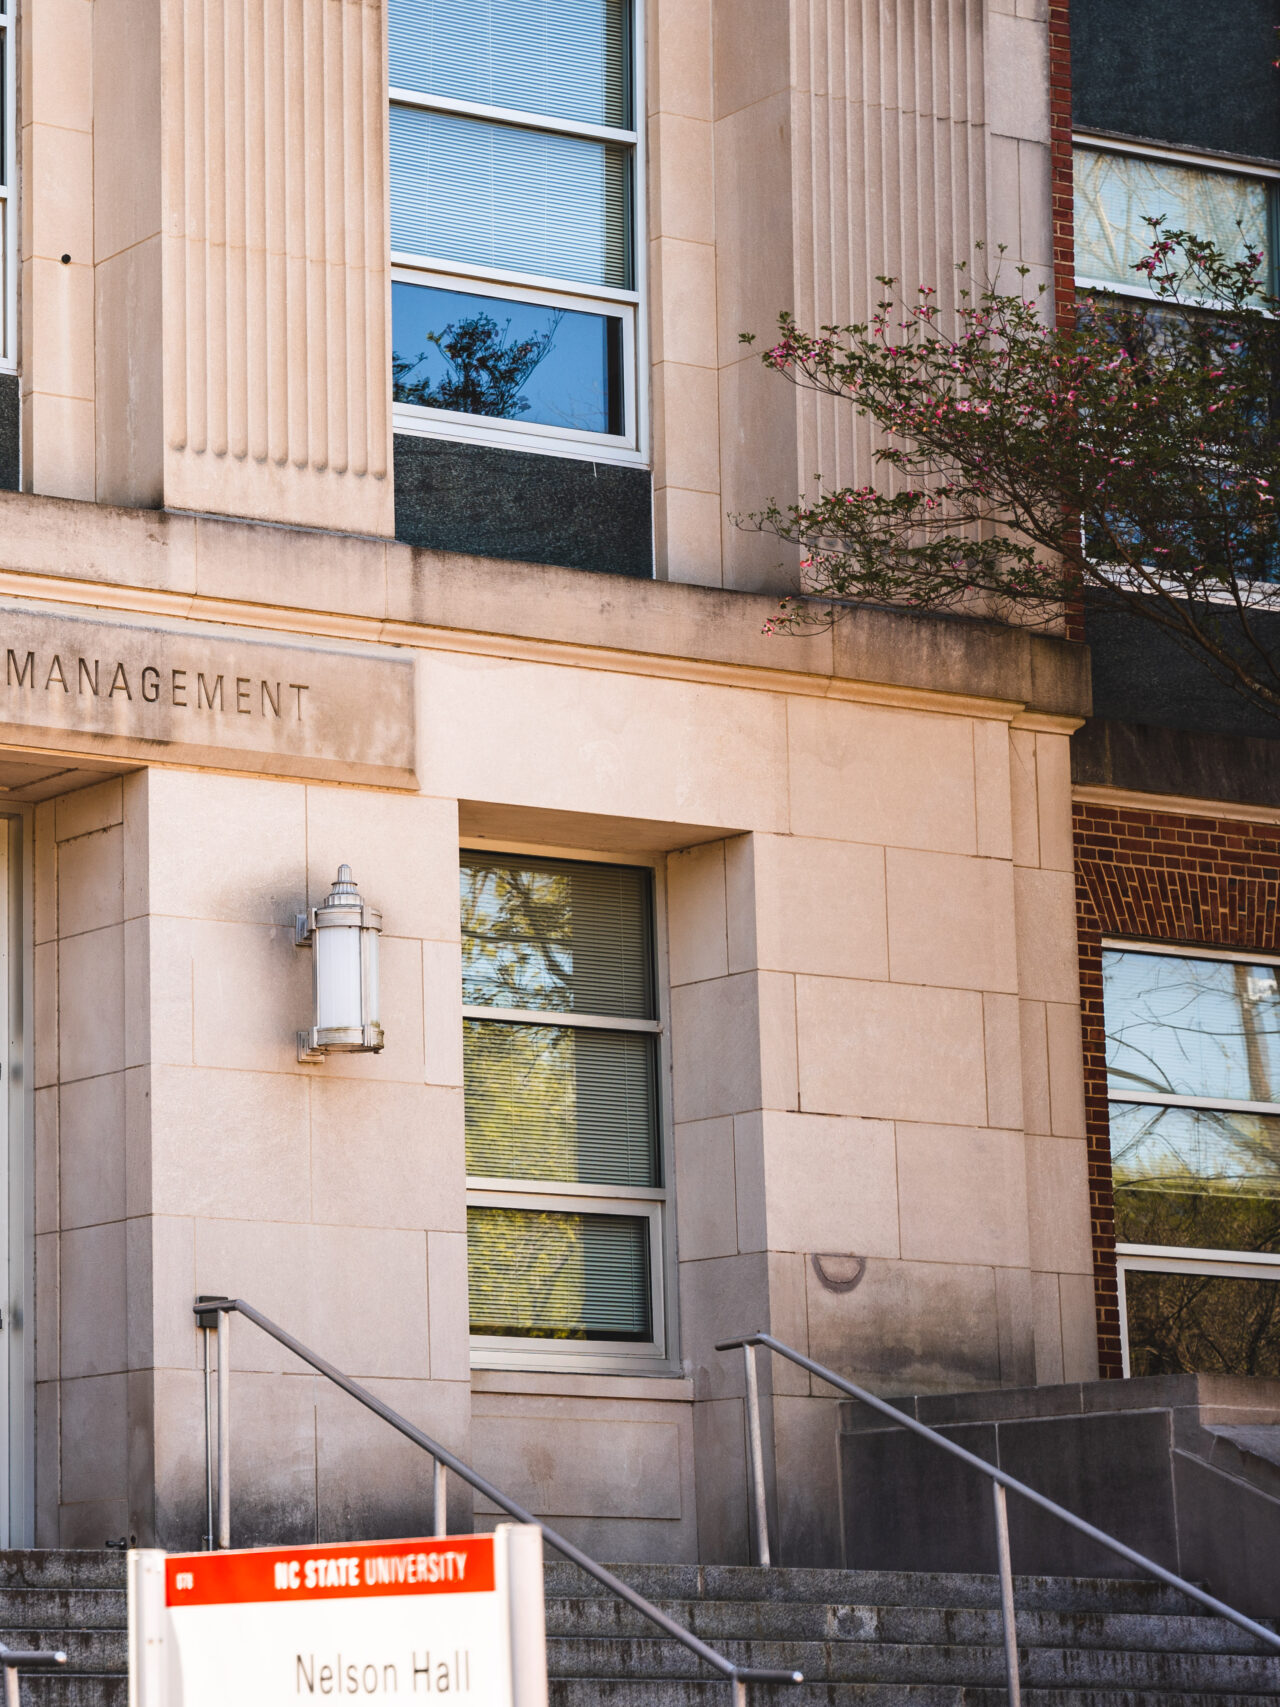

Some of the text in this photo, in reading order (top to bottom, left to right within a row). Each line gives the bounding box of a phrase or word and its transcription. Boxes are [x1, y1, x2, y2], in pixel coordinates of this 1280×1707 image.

[6, 648, 310, 721] MANAGEMENT
[274, 1561, 301, 1590] NC
[304, 1557, 360, 1589] STATE
[364, 1552, 468, 1586] UNIVERSITY
[295, 1650, 471, 1695] Nelson Hall
